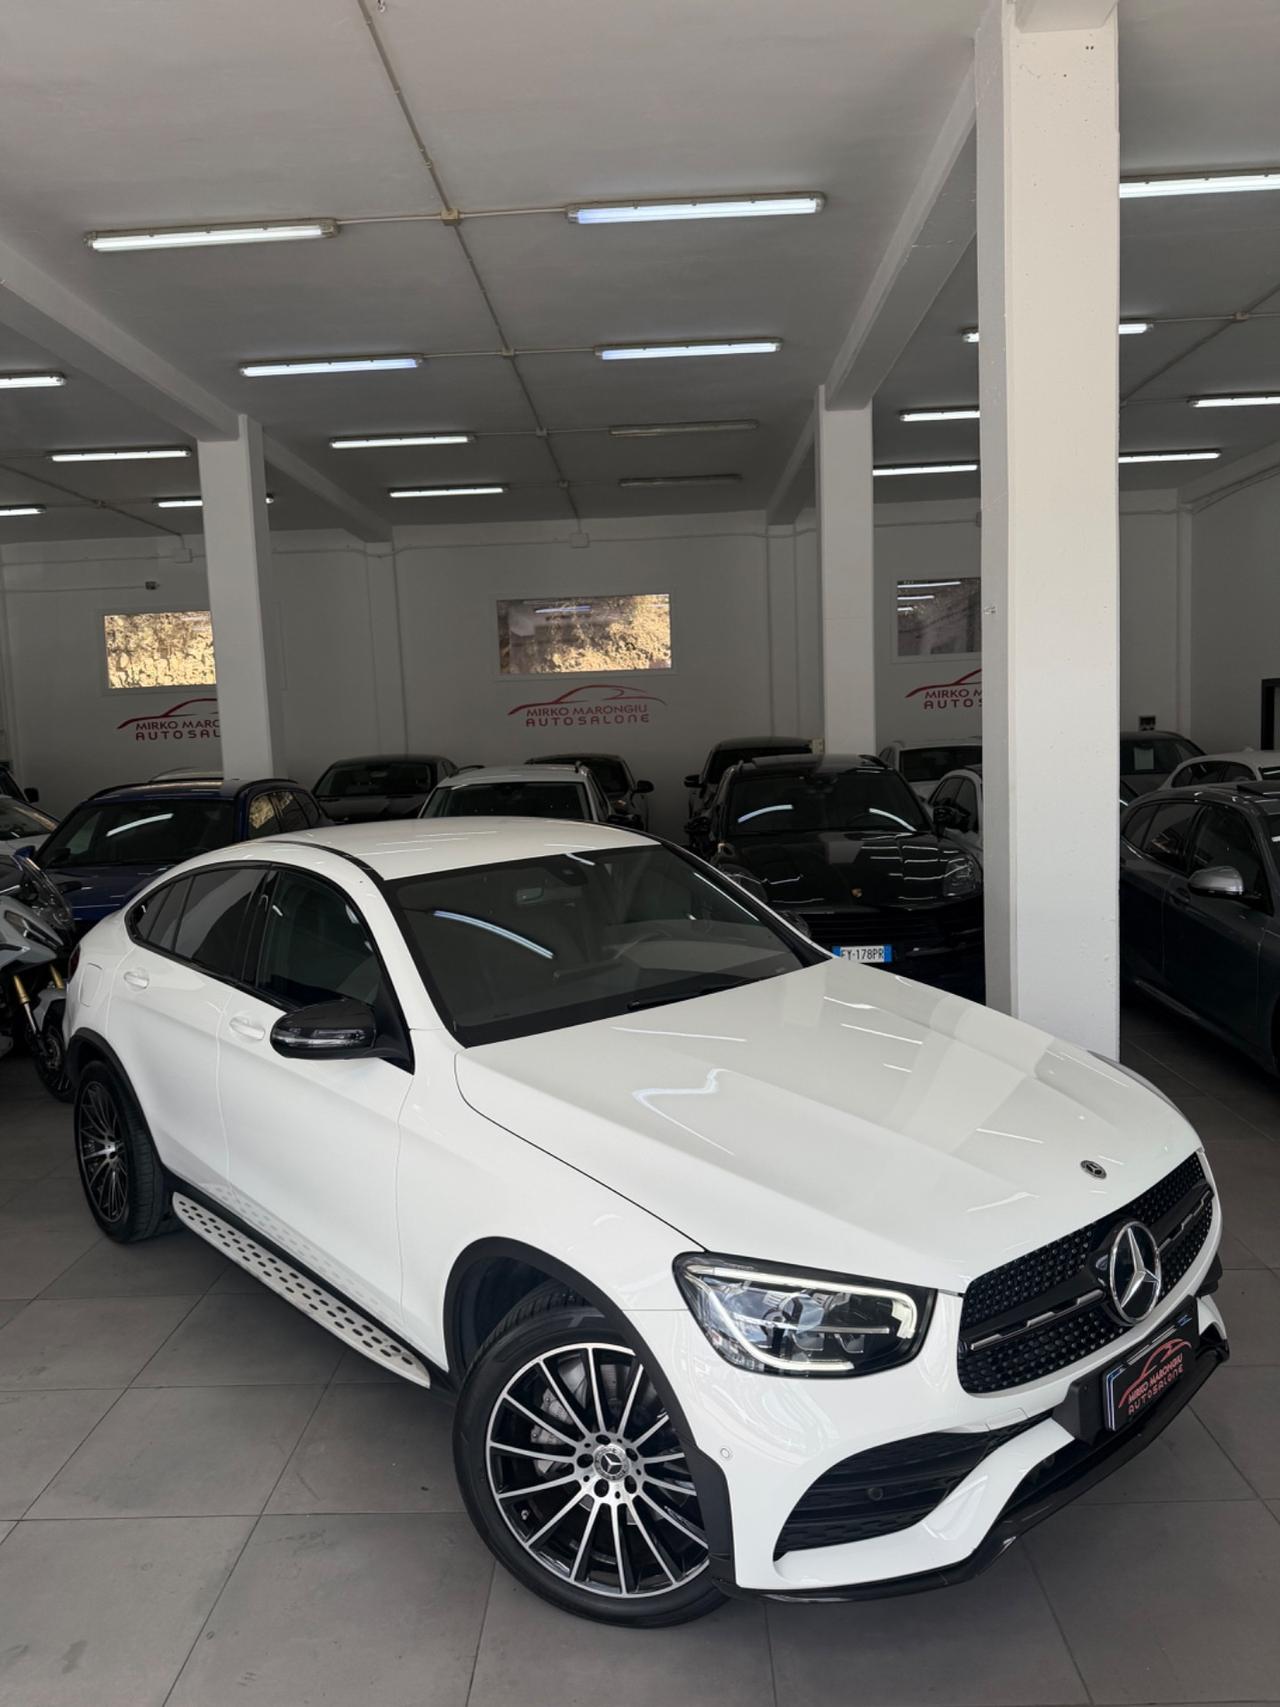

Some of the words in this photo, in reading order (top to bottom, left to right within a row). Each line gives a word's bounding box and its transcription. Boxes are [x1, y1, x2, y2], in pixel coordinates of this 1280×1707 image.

[925, 688, 970, 699] MIRKO
[526, 707, 569, 717] MIRKO
[572, 704, 648, 715] MARONGIU
[136, 720, 179, 731] MIRKO
[526, 713, 649, 727] AUTOSALONE
[1127, 1380, 1150, 1405] MIRKO
[1149, 1352, 1184, 1387] MARONGIU
[1127, 1363, 1184, 1416] AUTOSALONE
